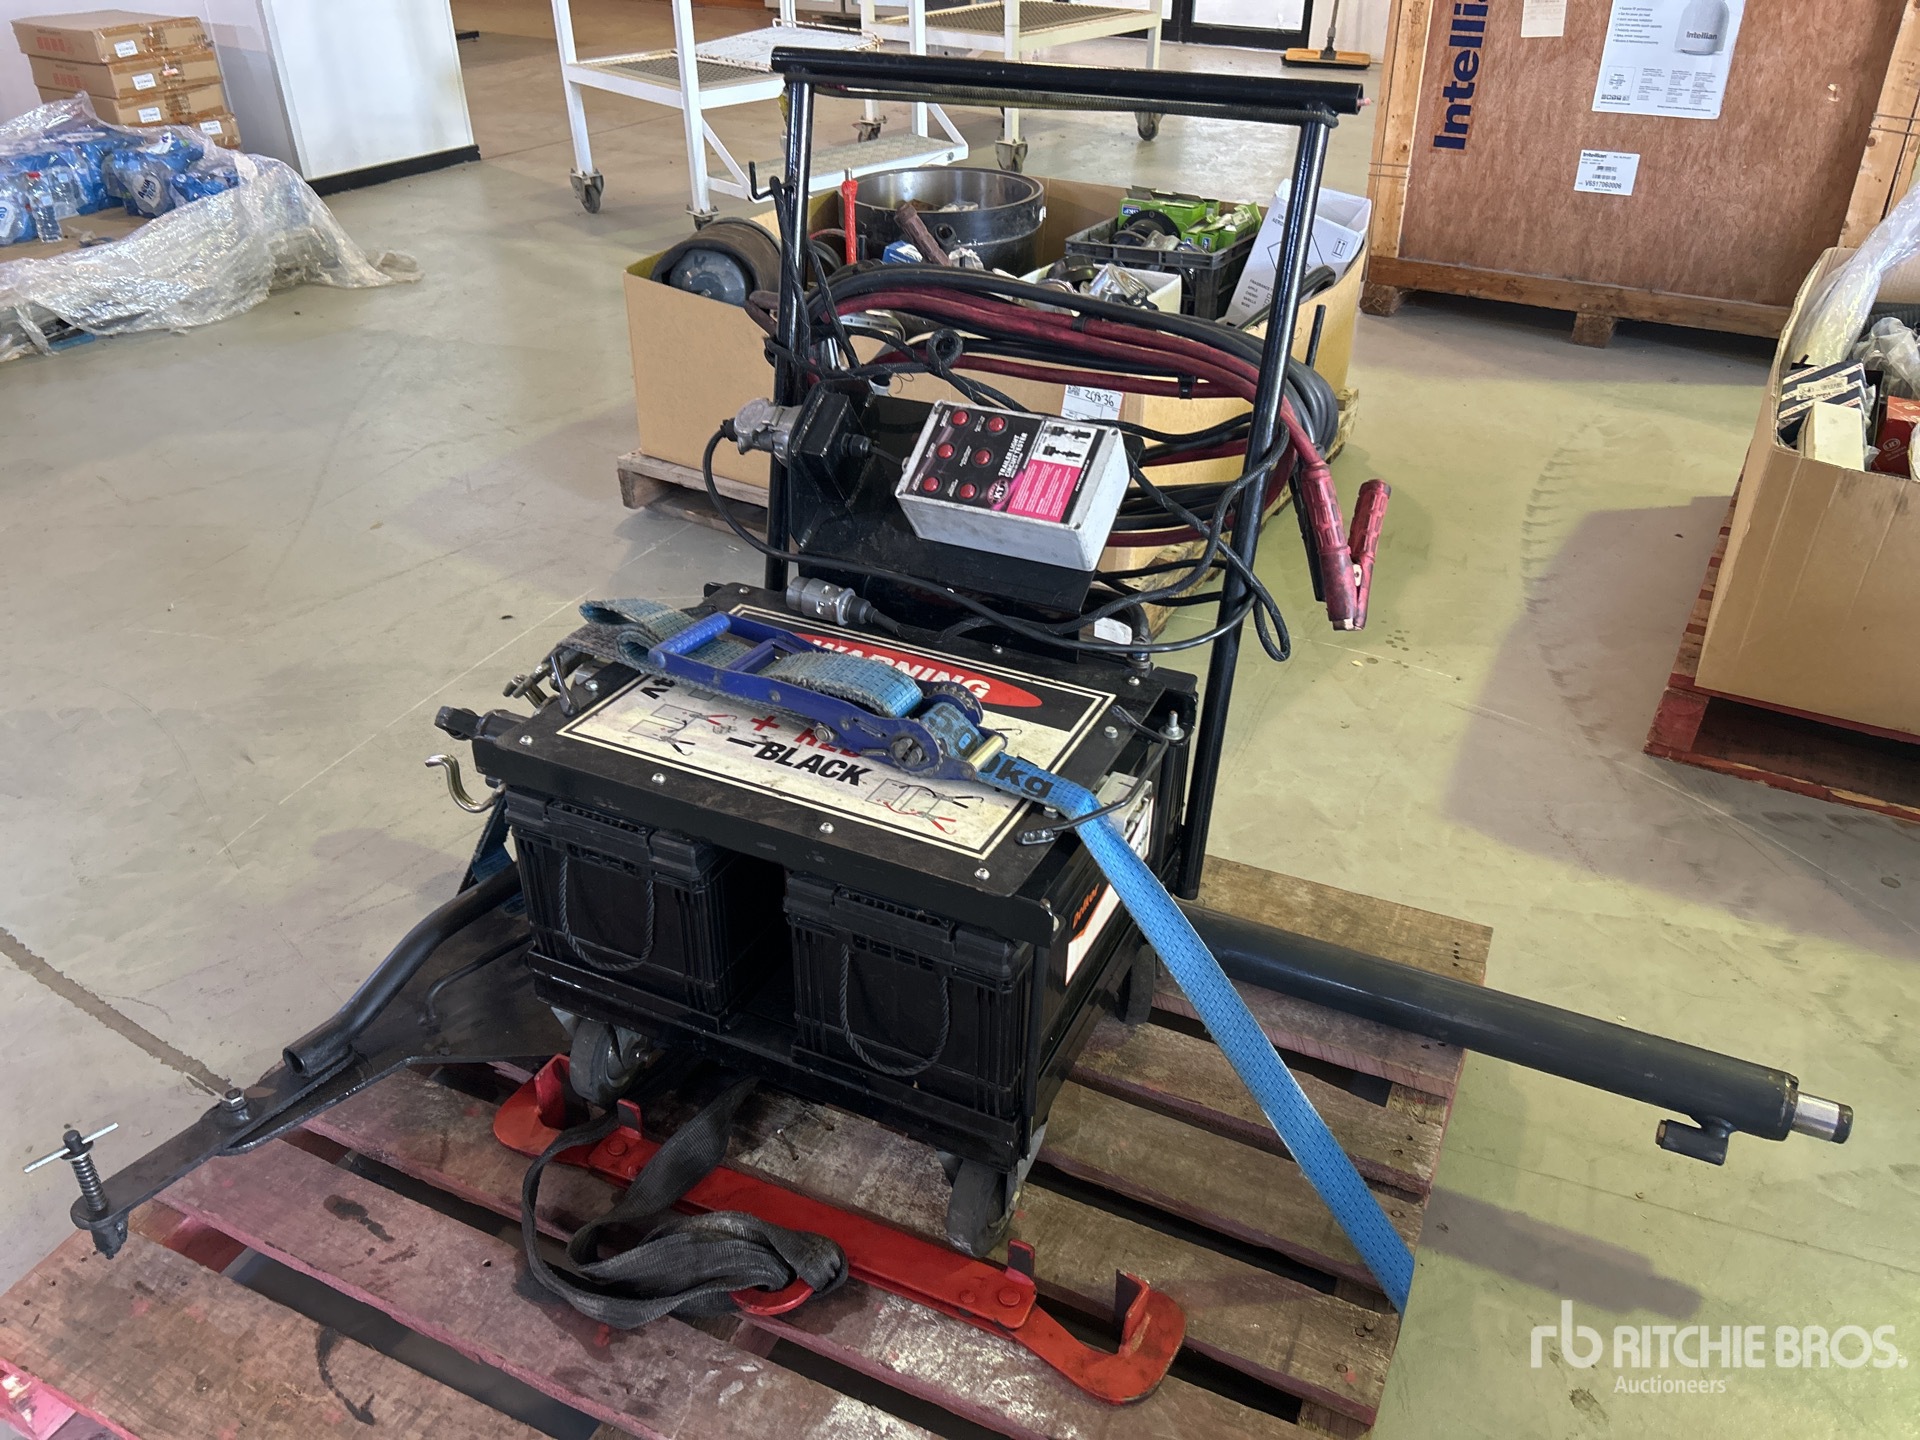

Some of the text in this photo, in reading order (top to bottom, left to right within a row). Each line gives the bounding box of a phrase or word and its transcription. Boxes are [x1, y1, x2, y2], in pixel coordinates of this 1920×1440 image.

[1433, 0, 1488, 150] Intelli
[998, 452, 1012, 476] TRAILER
[1009, 434, 1020, 453] LIGHT
[1004, 454, 1019, 478] CIRCUIT
[1014, 432, 1028, 454] TESTER
[812, 639, 991, 700] NING
